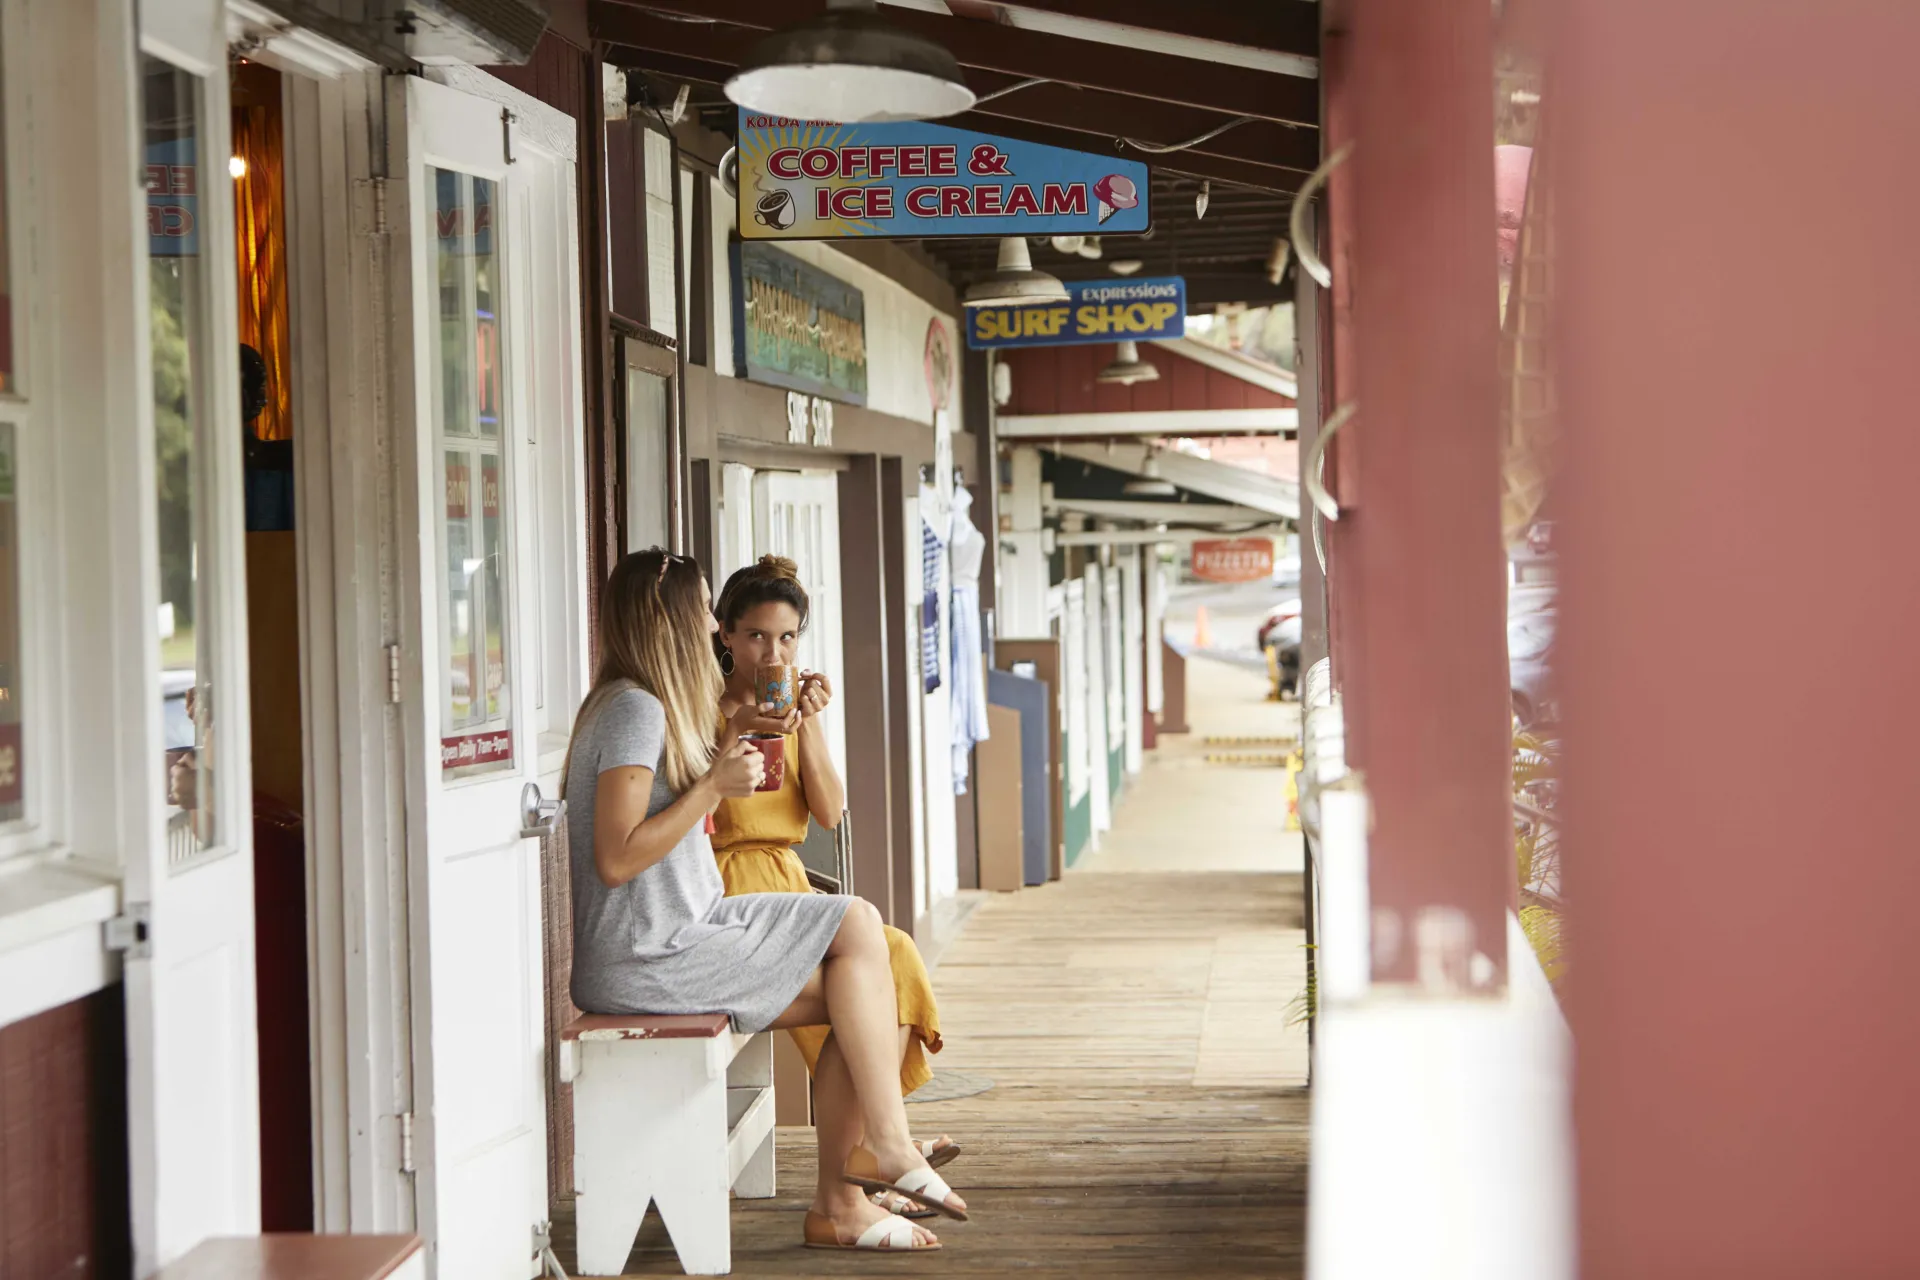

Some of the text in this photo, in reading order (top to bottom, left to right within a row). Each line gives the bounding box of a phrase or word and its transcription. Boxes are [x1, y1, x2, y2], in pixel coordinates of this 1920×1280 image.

[746, 116, 800, 128] KOLOA
[767, 143, 1014, 180] COFFEE &
[815, 183, 1089, 219] ICE CREAM
[976, 303, 1177, 339] SURF SHOP
[1197, 551, 1270, 570] PIZZETTA
